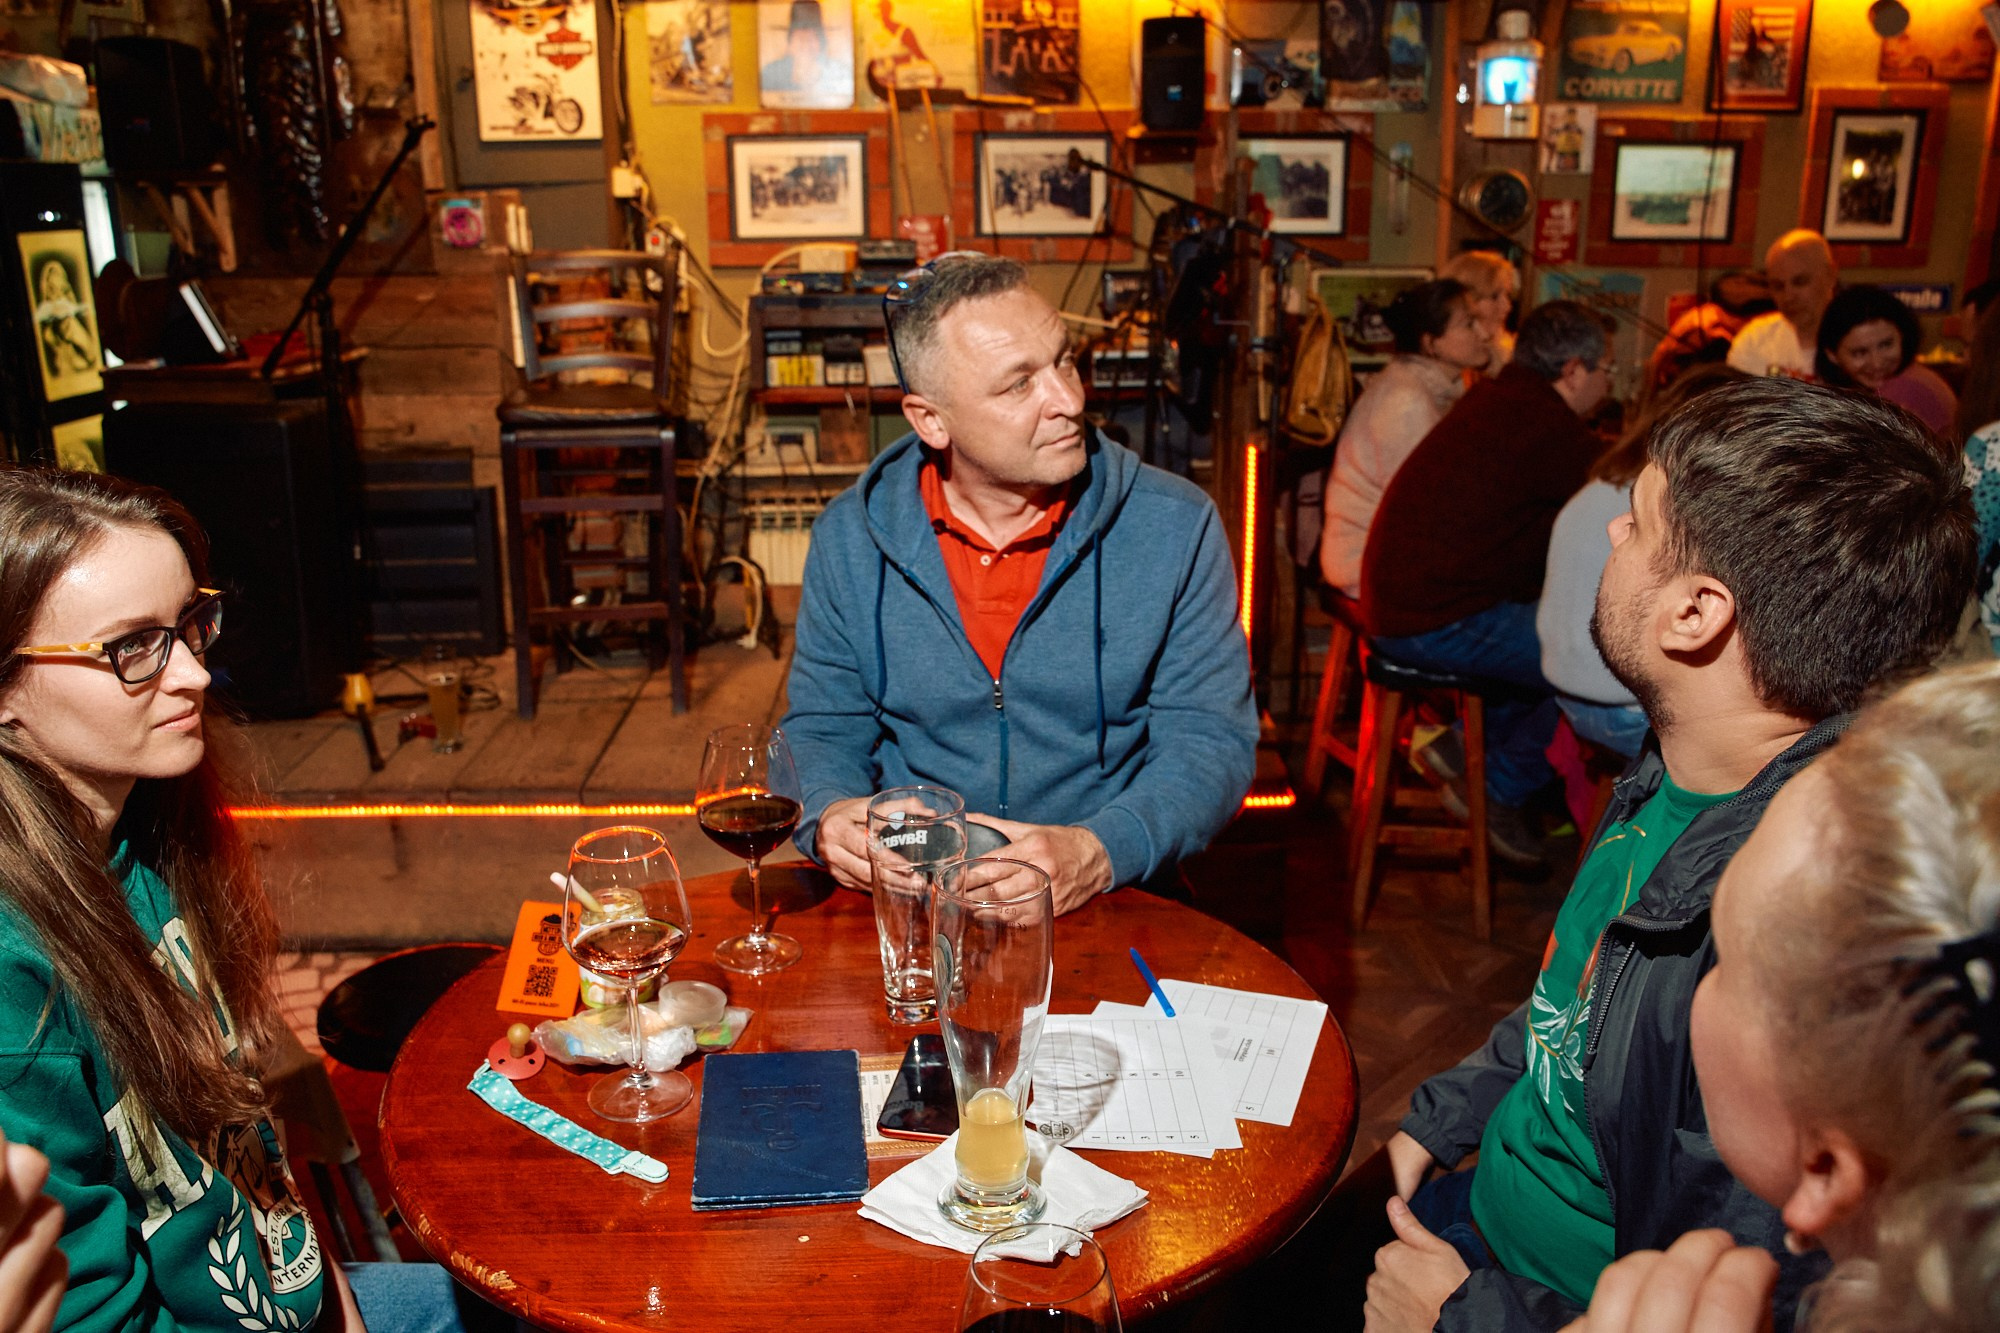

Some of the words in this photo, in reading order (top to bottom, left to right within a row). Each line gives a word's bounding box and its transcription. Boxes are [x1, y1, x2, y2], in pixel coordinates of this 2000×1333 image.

[1565, 77, 1677, 98] CORVETTE
[272, 1205, 292, 1223] 1886
[271, 1225, 280, 1257] EST.
